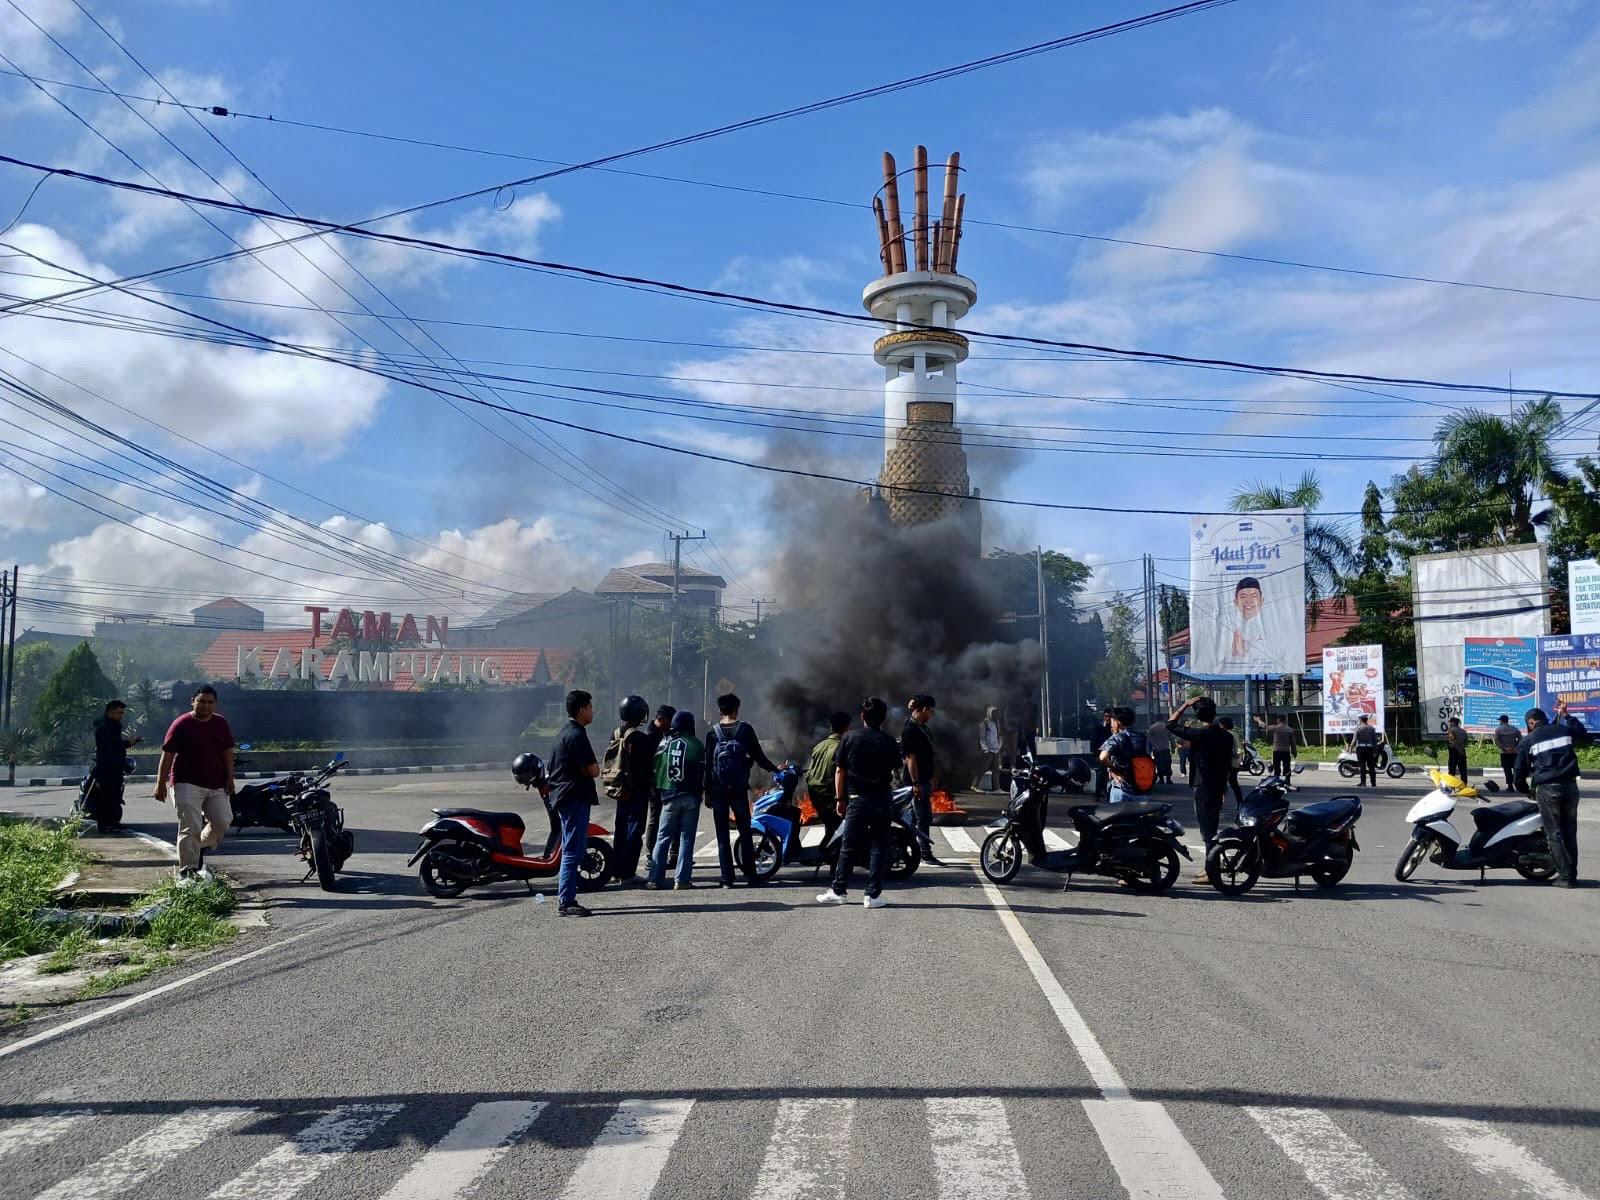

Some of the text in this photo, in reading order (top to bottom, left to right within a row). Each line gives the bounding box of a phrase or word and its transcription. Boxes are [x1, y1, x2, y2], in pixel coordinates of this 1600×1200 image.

[304, 606, 448, 646] TAMAN
[236, 645, 501, 685] KARAMPUANG
[1548, 660, 1572, 670] BAKAL
[1546, 670, 1577, 683] Bupati
[1546, 681, 1572, 693] Wakil
